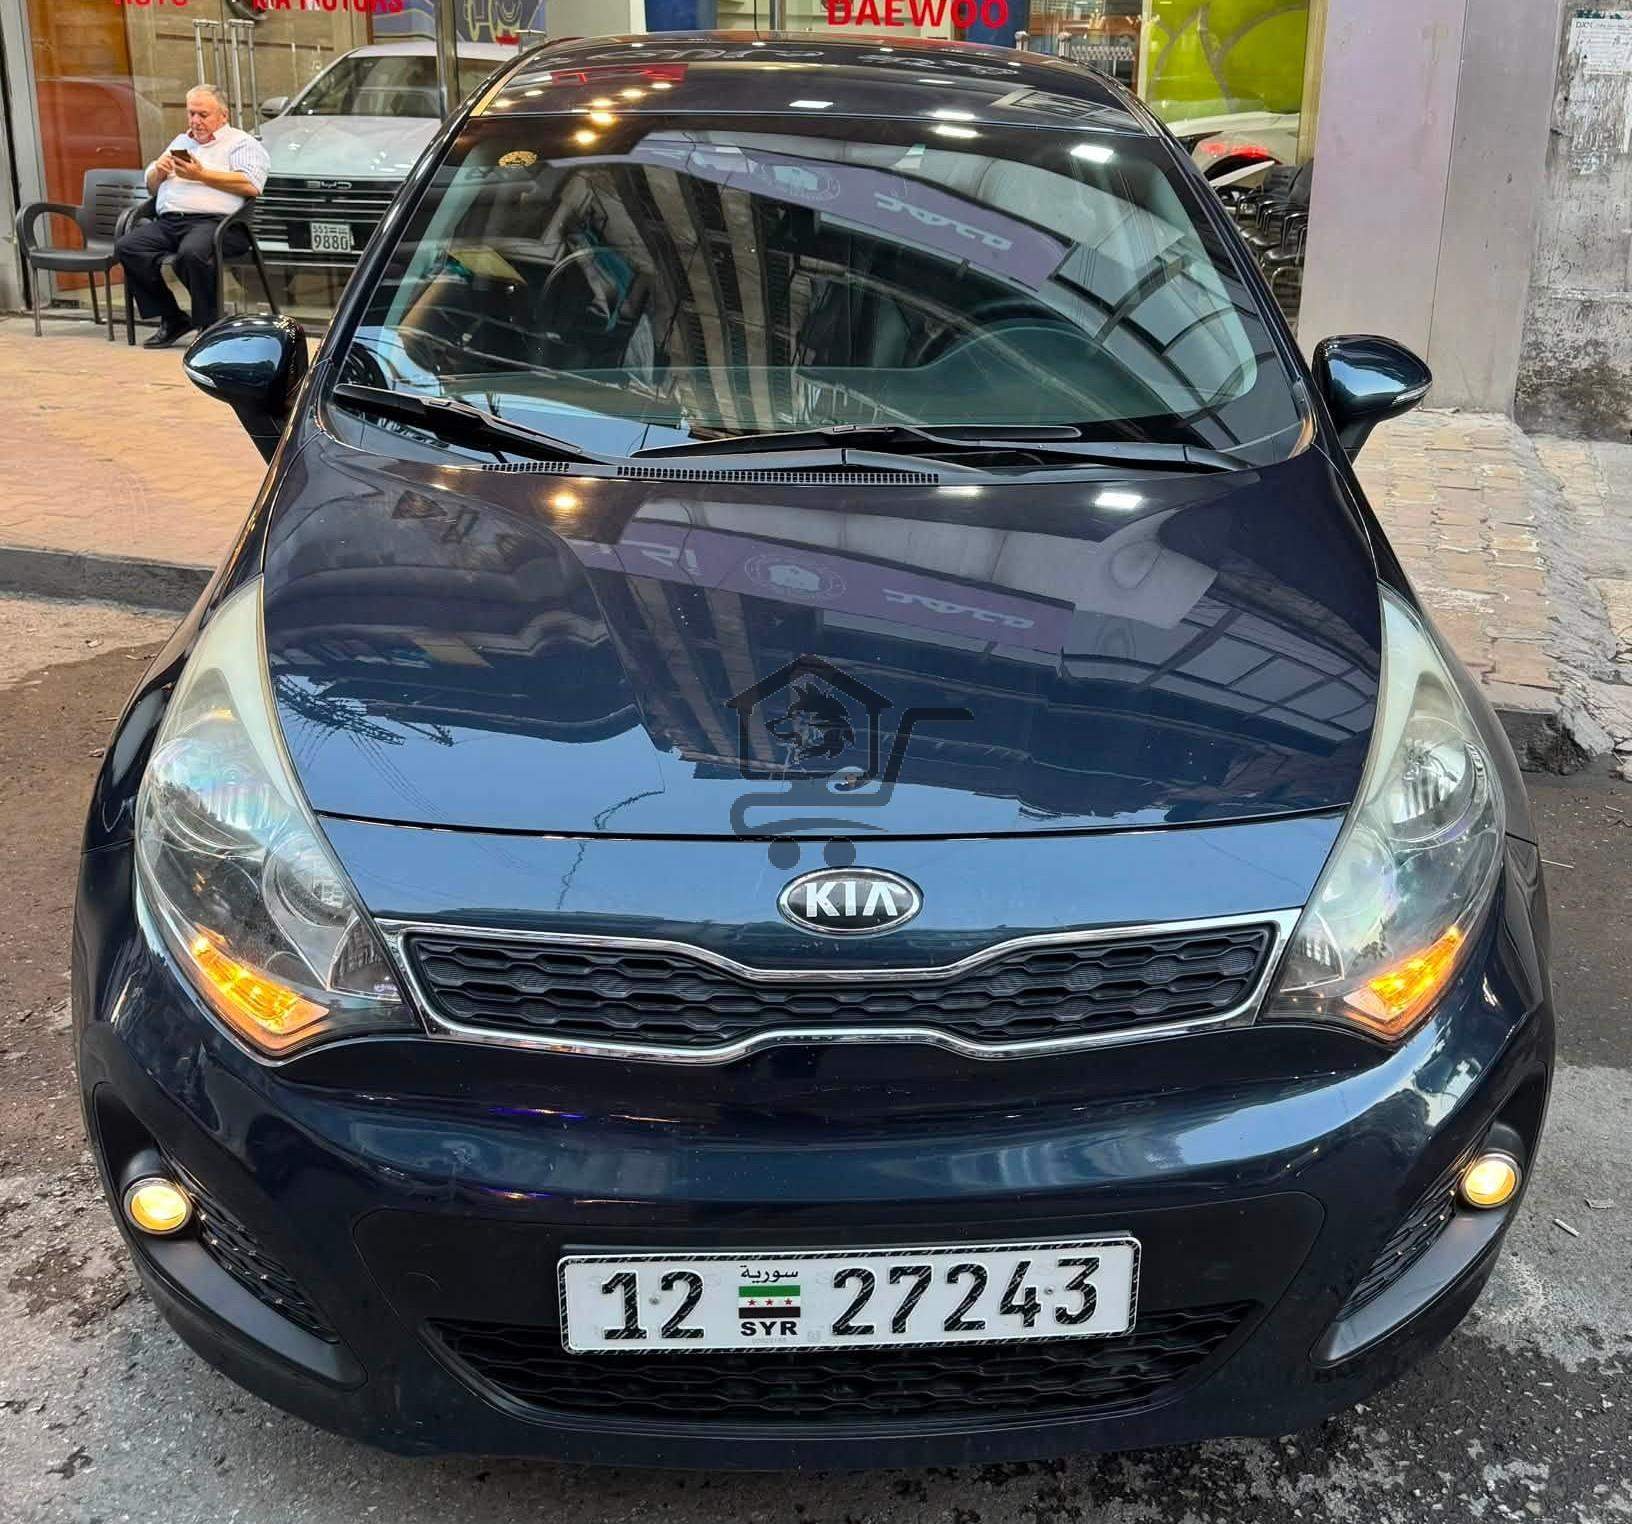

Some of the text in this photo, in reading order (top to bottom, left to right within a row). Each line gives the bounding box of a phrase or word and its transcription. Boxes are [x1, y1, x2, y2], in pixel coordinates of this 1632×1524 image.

[827, 0, 1009, 29] DAEWOO
[313, 234, 349, 251] 9880
[804, 880, 907, 917] KIA
[740, 1264, 799, 1284] سورية
[601, 1256, 1100, 1340] 12 27243
[740, 1321, 799, 1337] SYR
